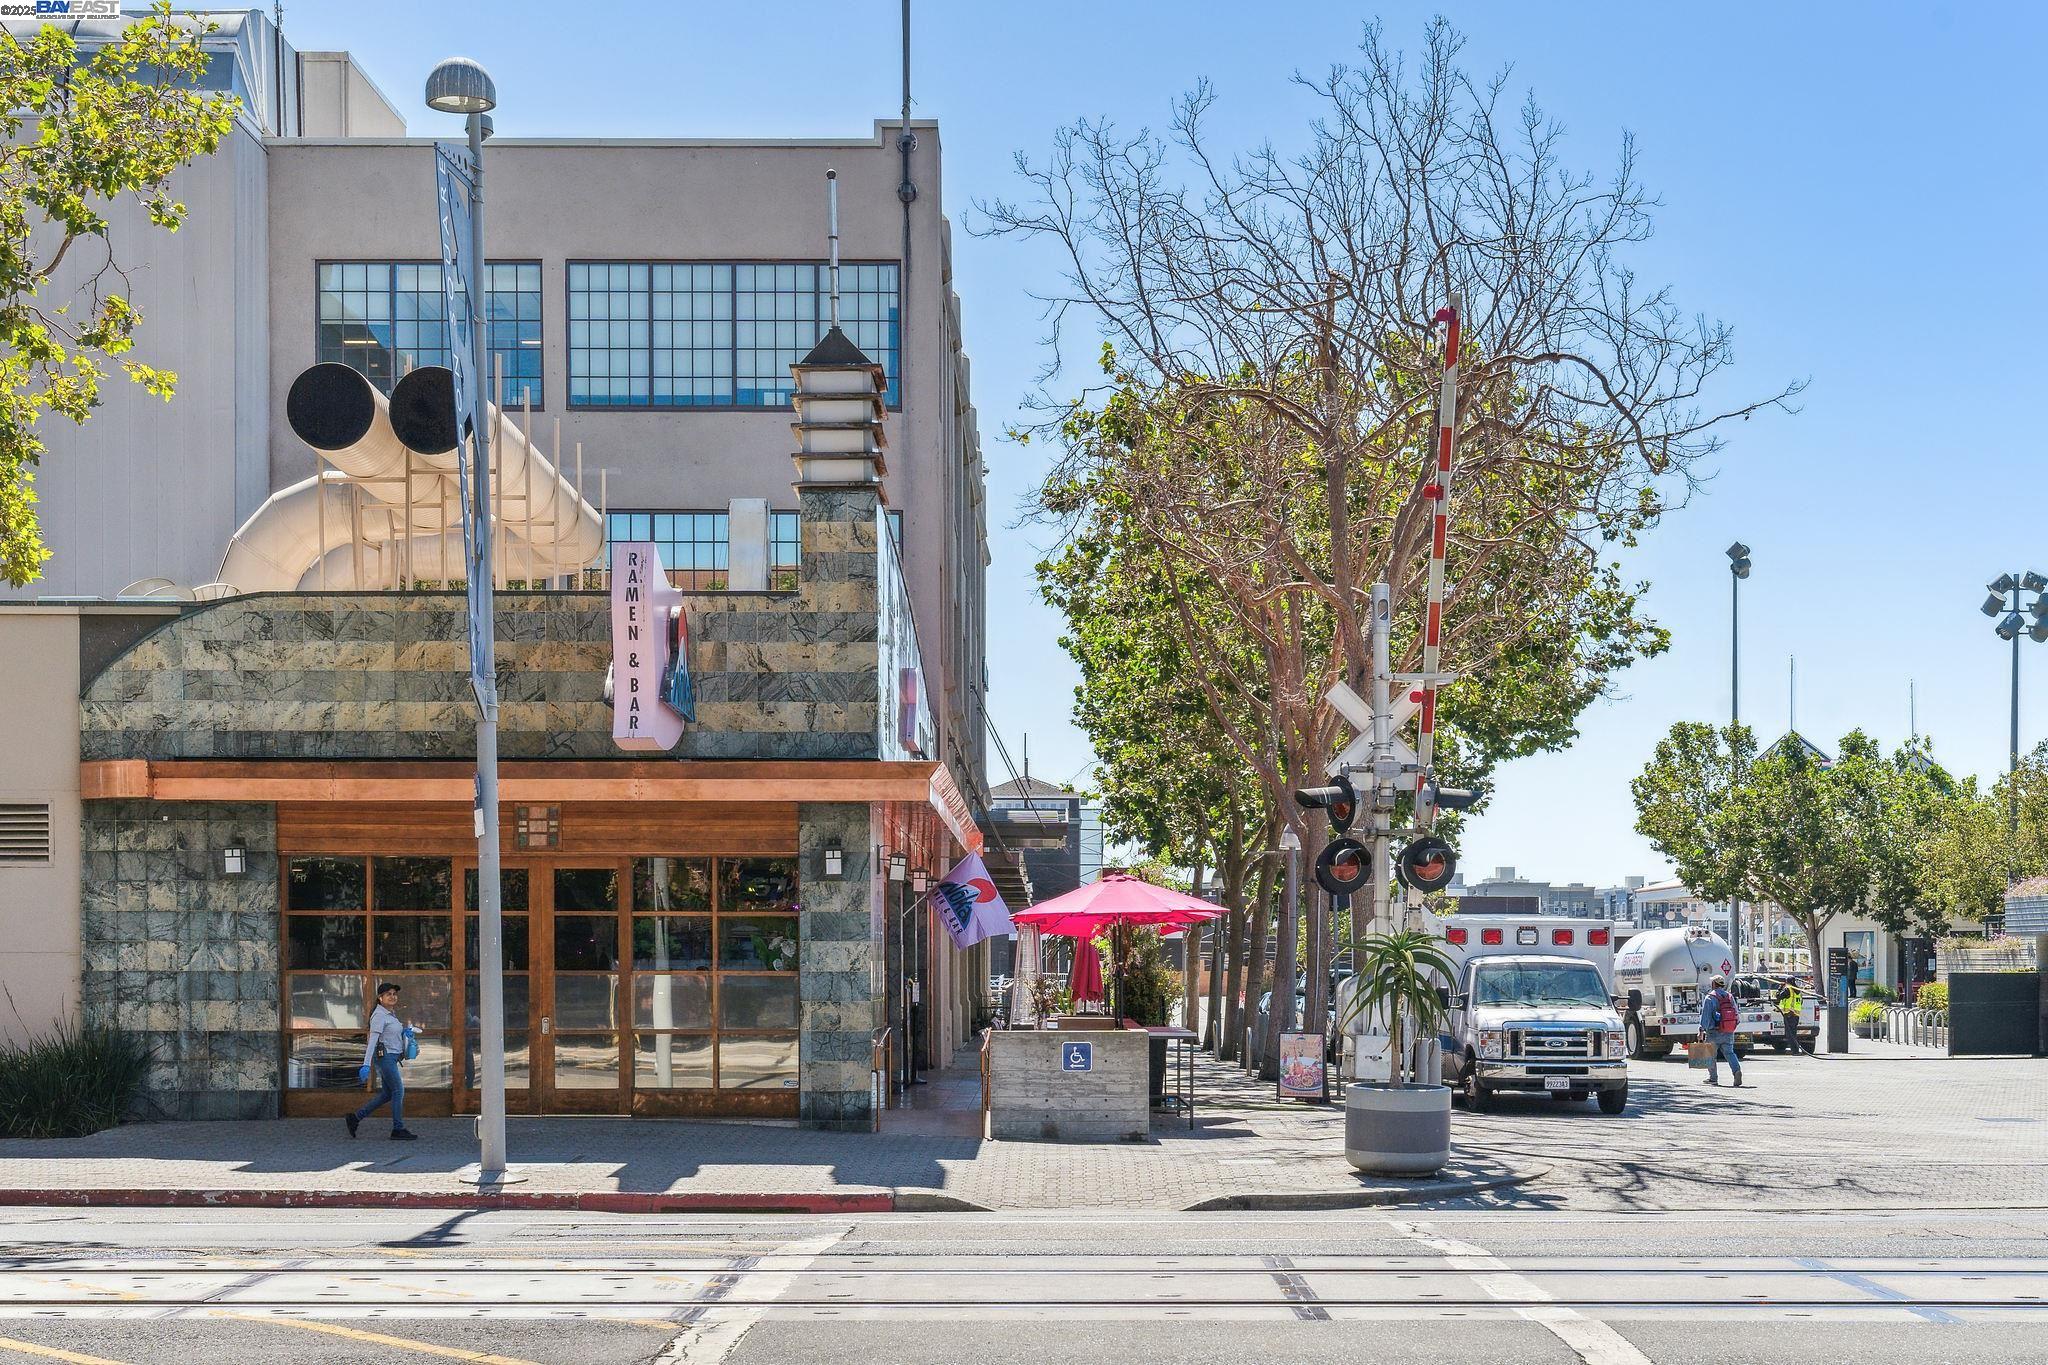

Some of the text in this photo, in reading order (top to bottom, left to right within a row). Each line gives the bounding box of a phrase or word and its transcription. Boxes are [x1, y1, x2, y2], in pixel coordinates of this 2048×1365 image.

[438, 157, 457, 326] SQUARE
[453, 353, 471, 541] LONDON
[625, 552, 640, 730] RAMEN & BAR
